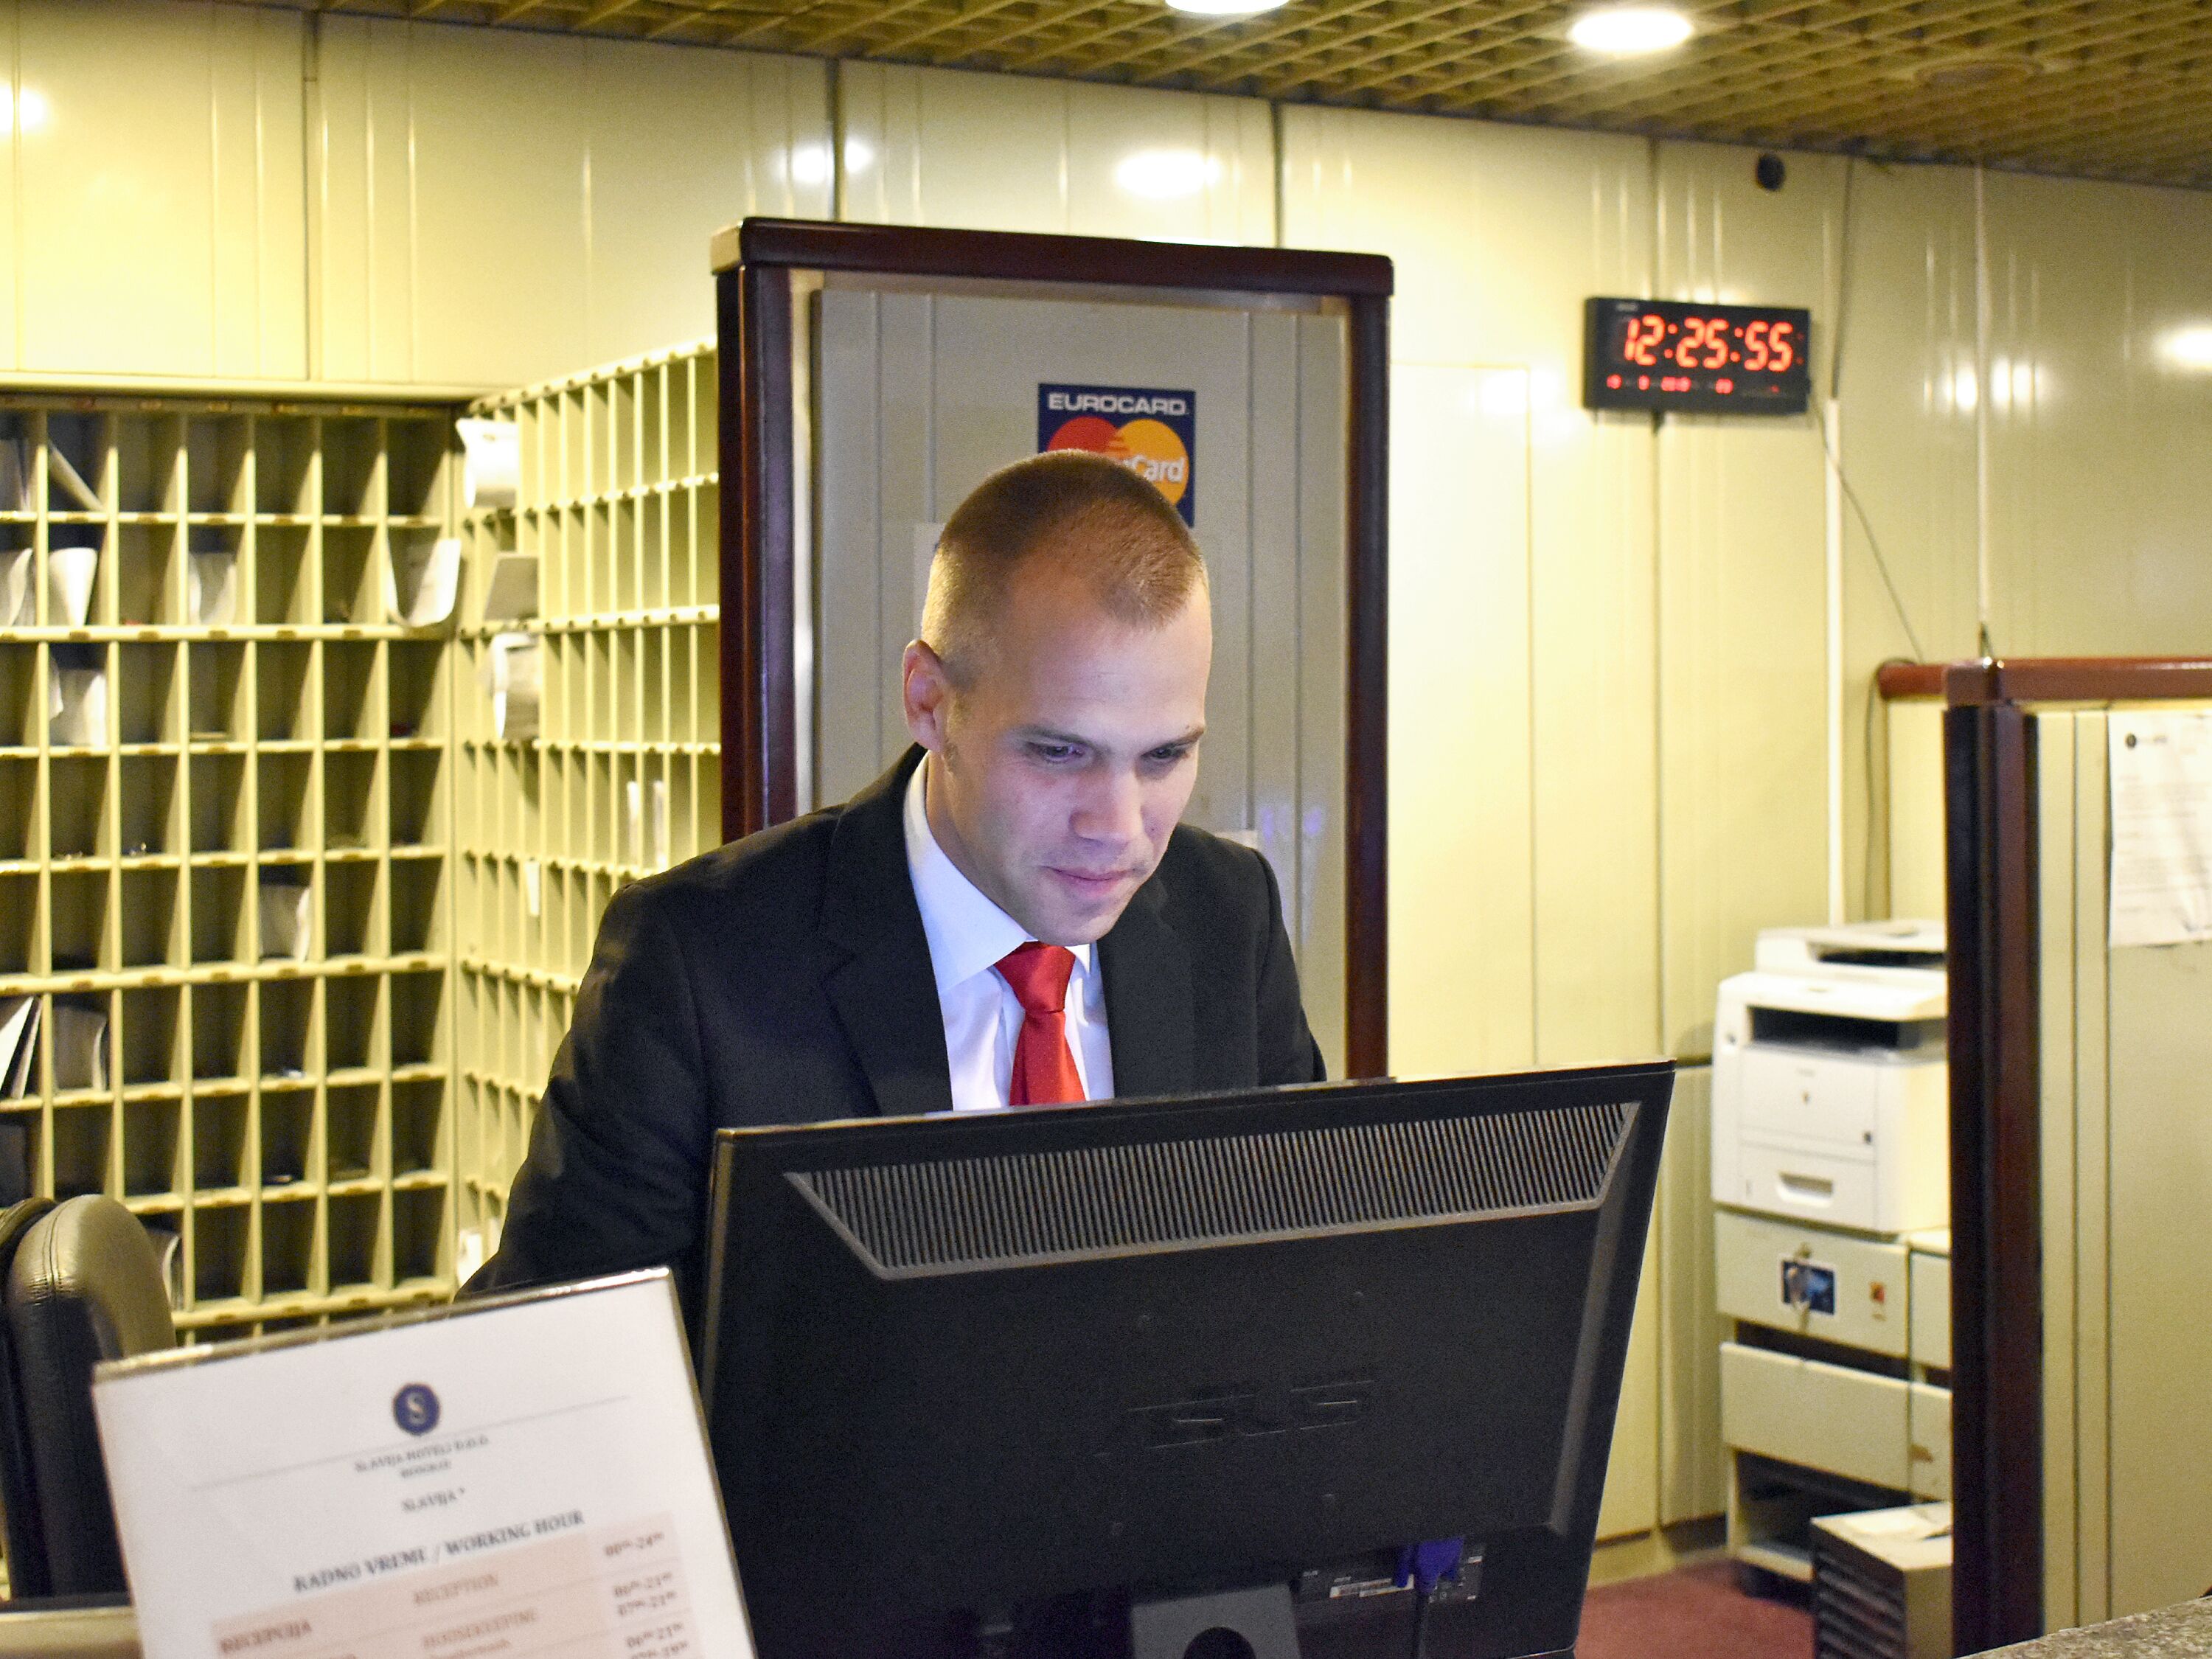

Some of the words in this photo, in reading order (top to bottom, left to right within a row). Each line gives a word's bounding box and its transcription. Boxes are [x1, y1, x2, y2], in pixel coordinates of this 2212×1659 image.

[1624, 314, 1793, 372] 12:25:55
[1048, 392, 1186, 416] EUROCARD
[294, 1563, 361, 1592] RADNO
[365, 1548, 425, 1573] VREME
[445, 1523, 530, 1554] WORKING
[534, 1509, 584, 1534] HOUR
[414, 1574, 498, 1604] RECEPTION
